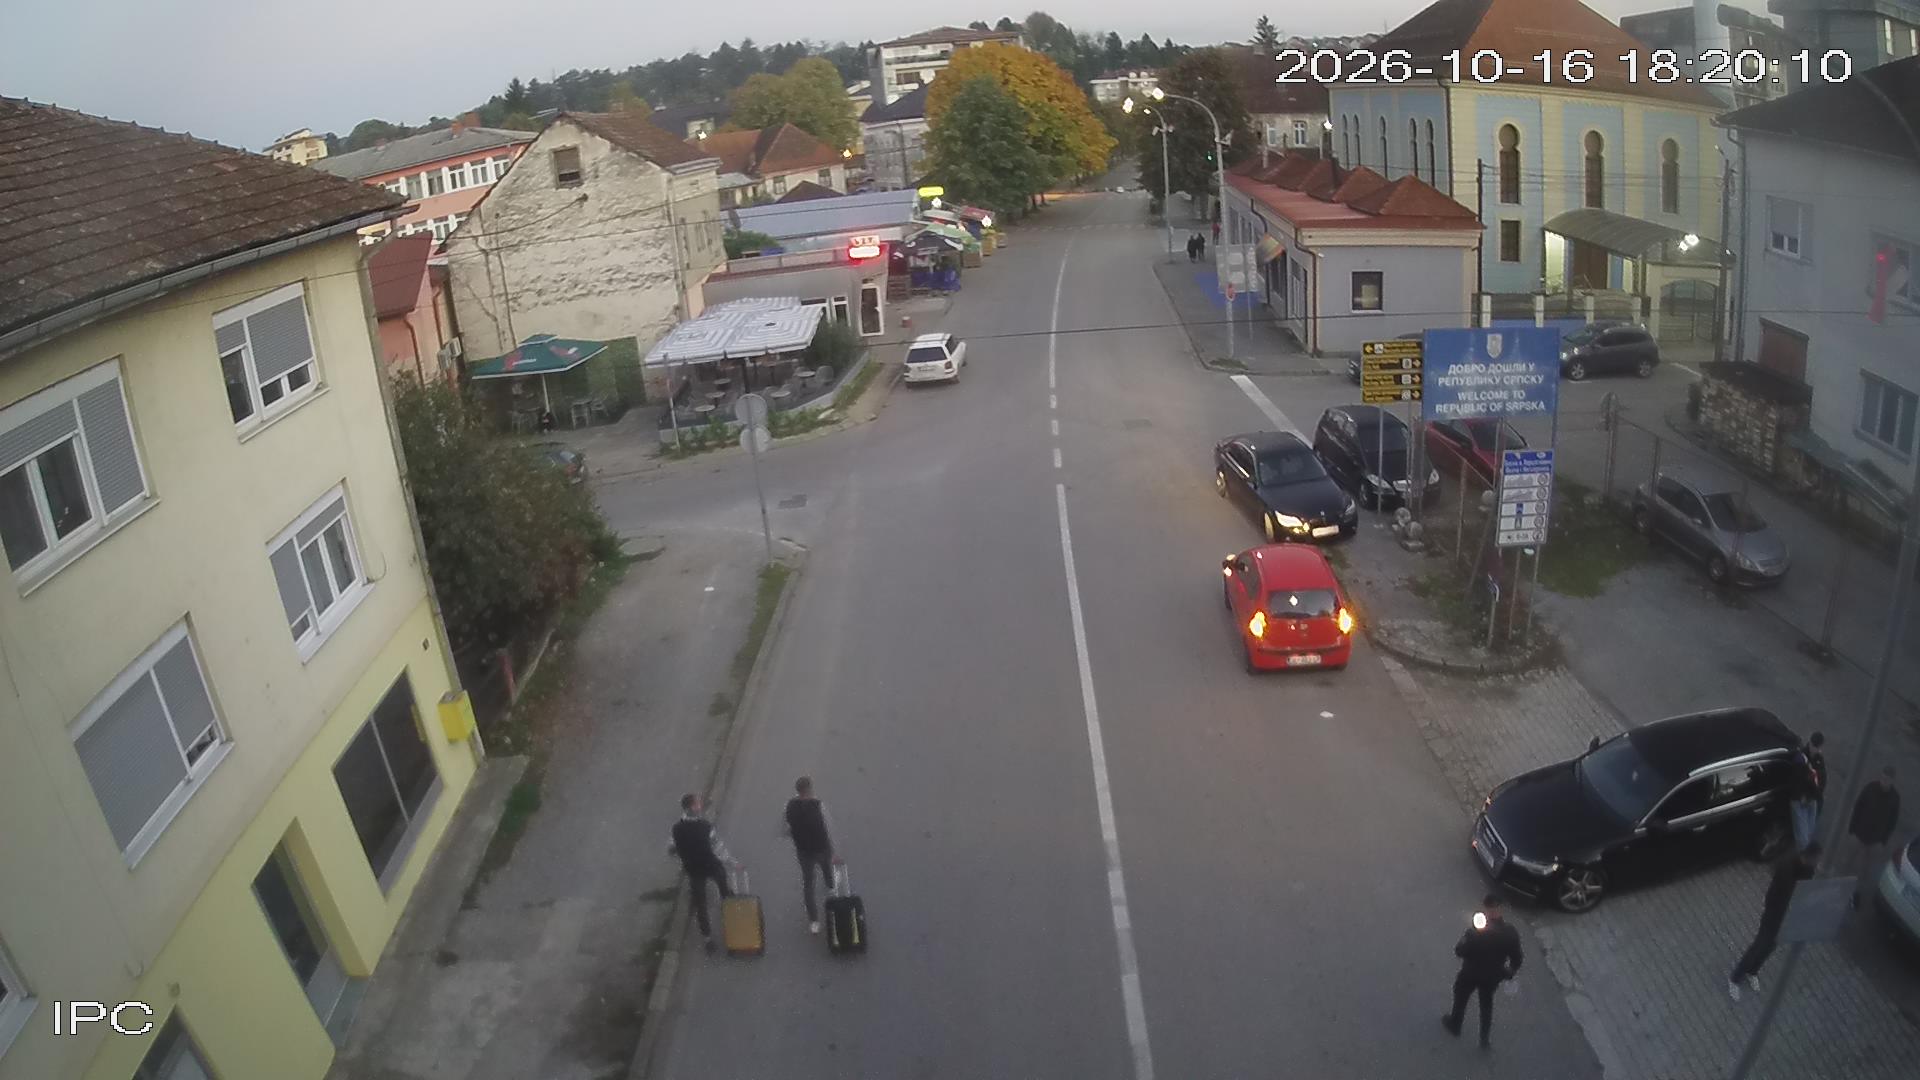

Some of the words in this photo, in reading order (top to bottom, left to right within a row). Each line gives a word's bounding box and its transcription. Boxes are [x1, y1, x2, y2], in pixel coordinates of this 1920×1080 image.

[1447, 364, 1486, 376] ДОБРО
[1487, 363, 1526, 375] ДОШЛИ
[1528, 363, 1535, 372] У
[1438, 377, 1501, 386] РЕПУБЛИКУ
[1502, 375, 1545, 385] СРПСКУ
[1457, 390, 1509, 401] WELCOME
[1511, 390, 1526, 400] TO
[1435, 404, 1488, 414] REPUBLIC
[1489, 402, 1504, 412] OF
[1505, 400, 1546, 412] SRPSKA
